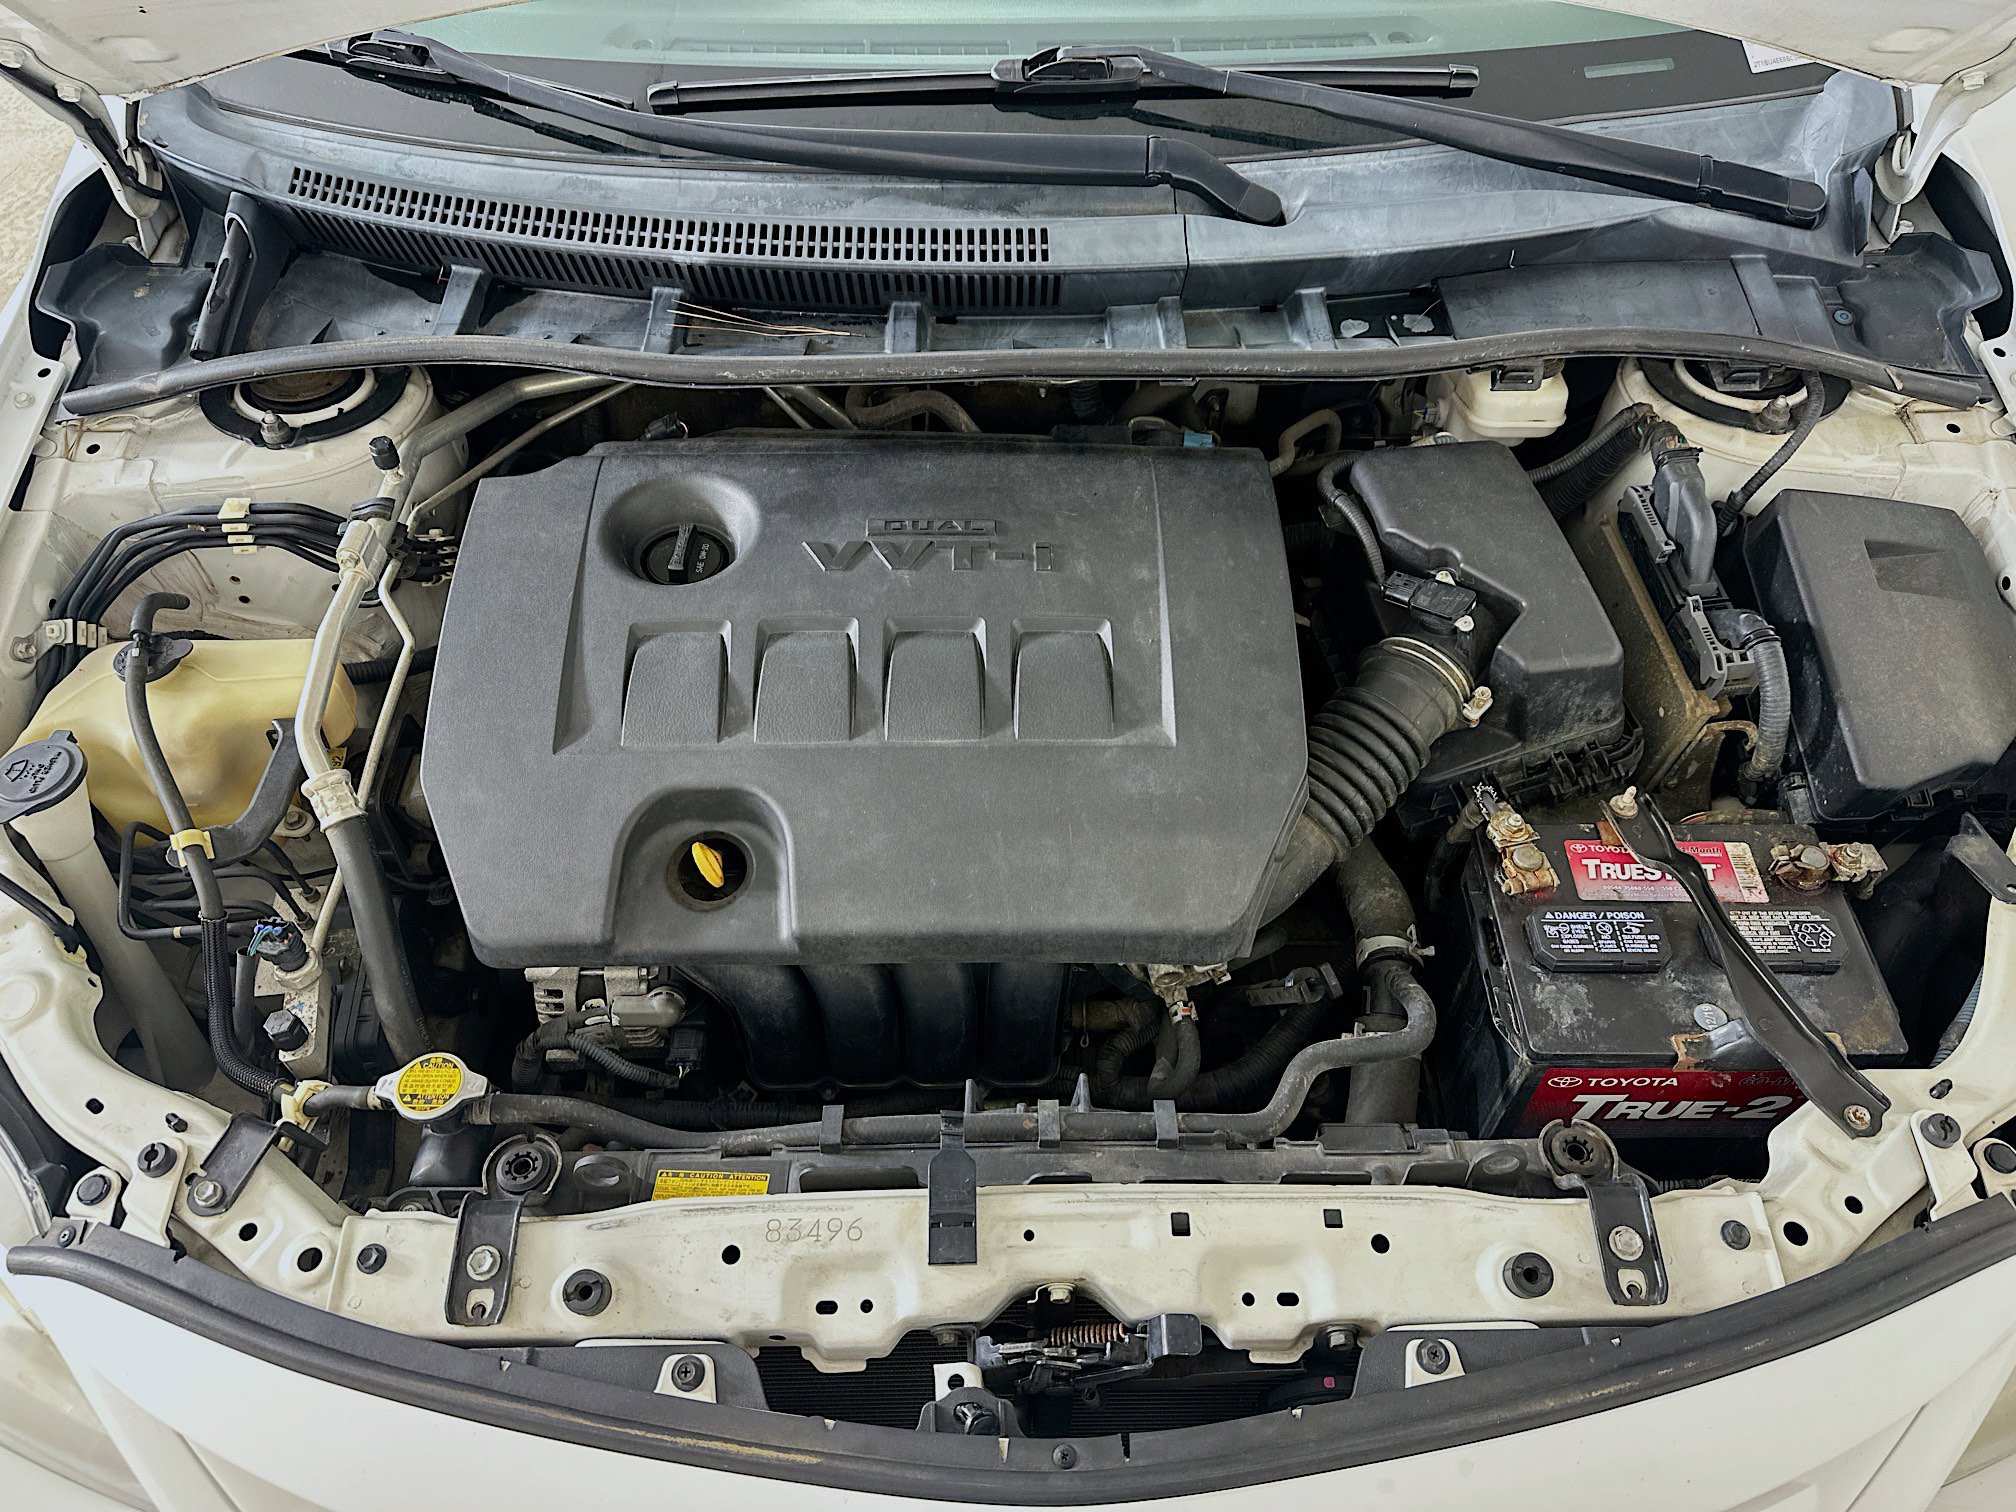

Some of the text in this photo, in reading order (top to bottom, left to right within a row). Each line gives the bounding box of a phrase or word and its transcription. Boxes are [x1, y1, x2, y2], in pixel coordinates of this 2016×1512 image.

[884, 520, 984, 531] DUAL
[695, 543, 710, 573] SAE 0W-20
[1588, 844, 1631, 854] TOYOT
[1581, 859, 1716, 881] TRUEST
[1702, 1004, 1718, 1030] 12/19
[1587, 1077, 1678, 1086] TOYOTA
[1571, 1094, 1793, 1119] TRUE-2
[765, 1217, 863, 1242] 83496
